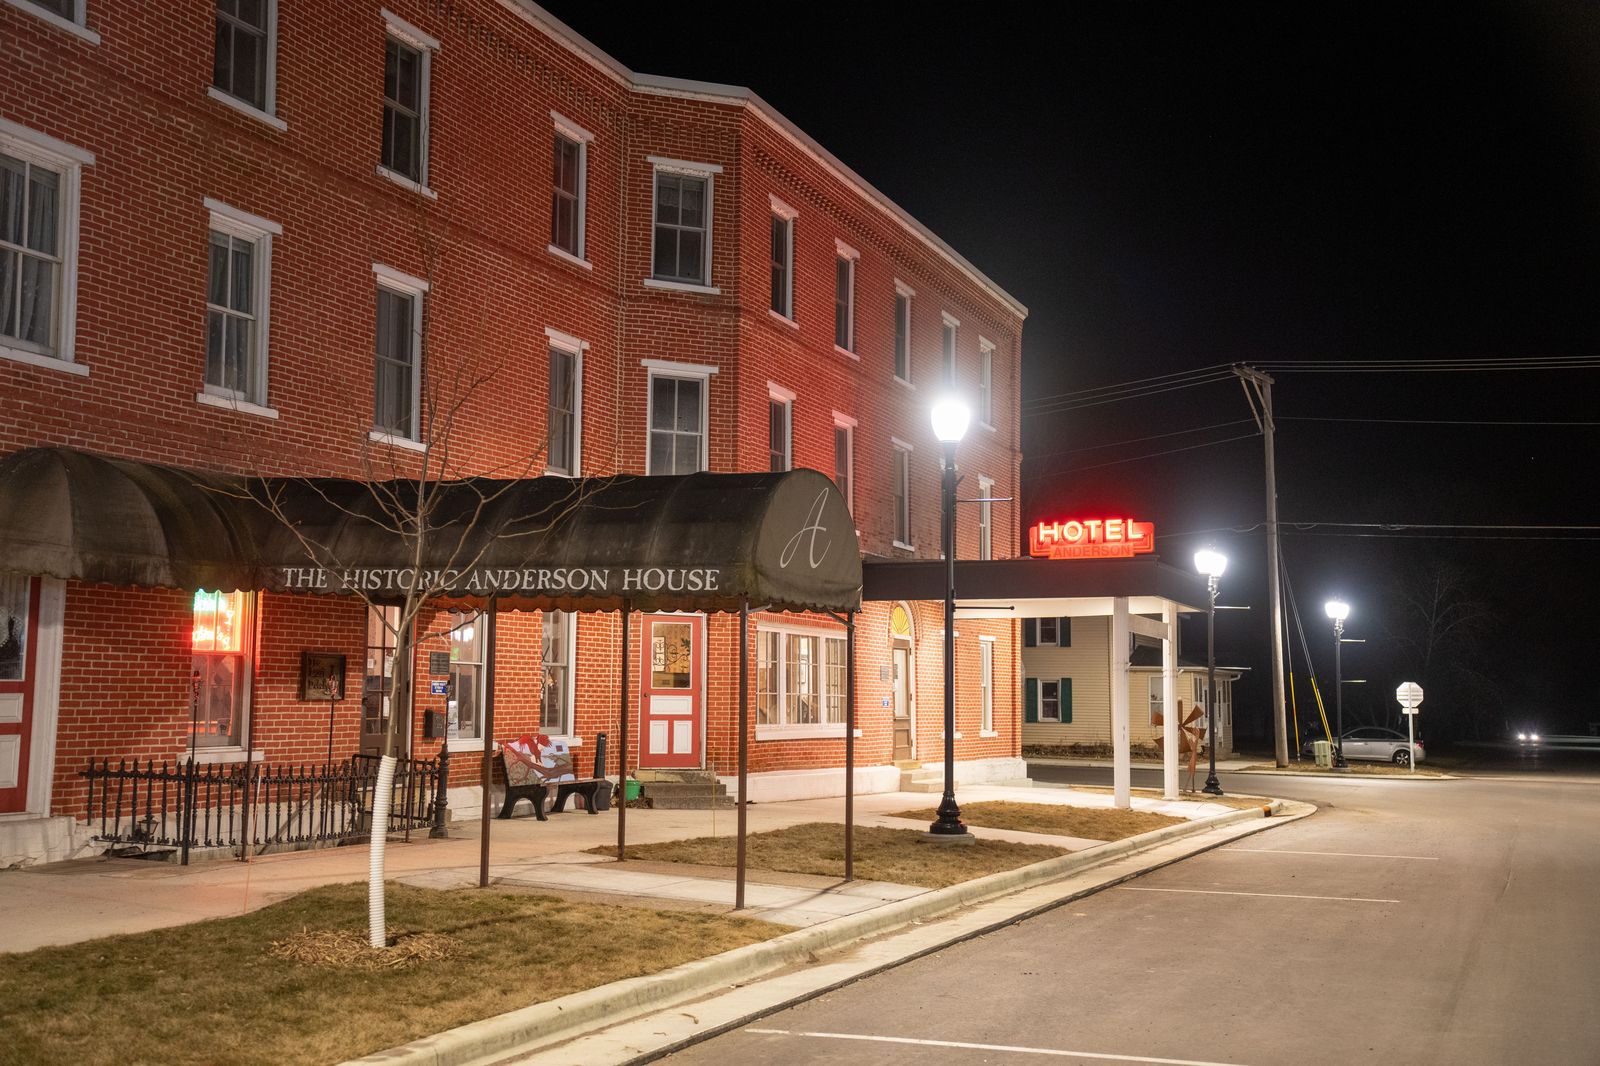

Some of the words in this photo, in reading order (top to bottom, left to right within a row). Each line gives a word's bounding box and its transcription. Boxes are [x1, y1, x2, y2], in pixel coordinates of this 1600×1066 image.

[1039, 518, 1144, 542] HOTEL
[1053, 544, 1131, 558] ANDERSON
[283, 567, 328, 588] THE
[341, 568, 459, 590] HISTORIC
[464, 568, 610, 590] ANDERSON
[622, 568, 720, 591] HOUSE
